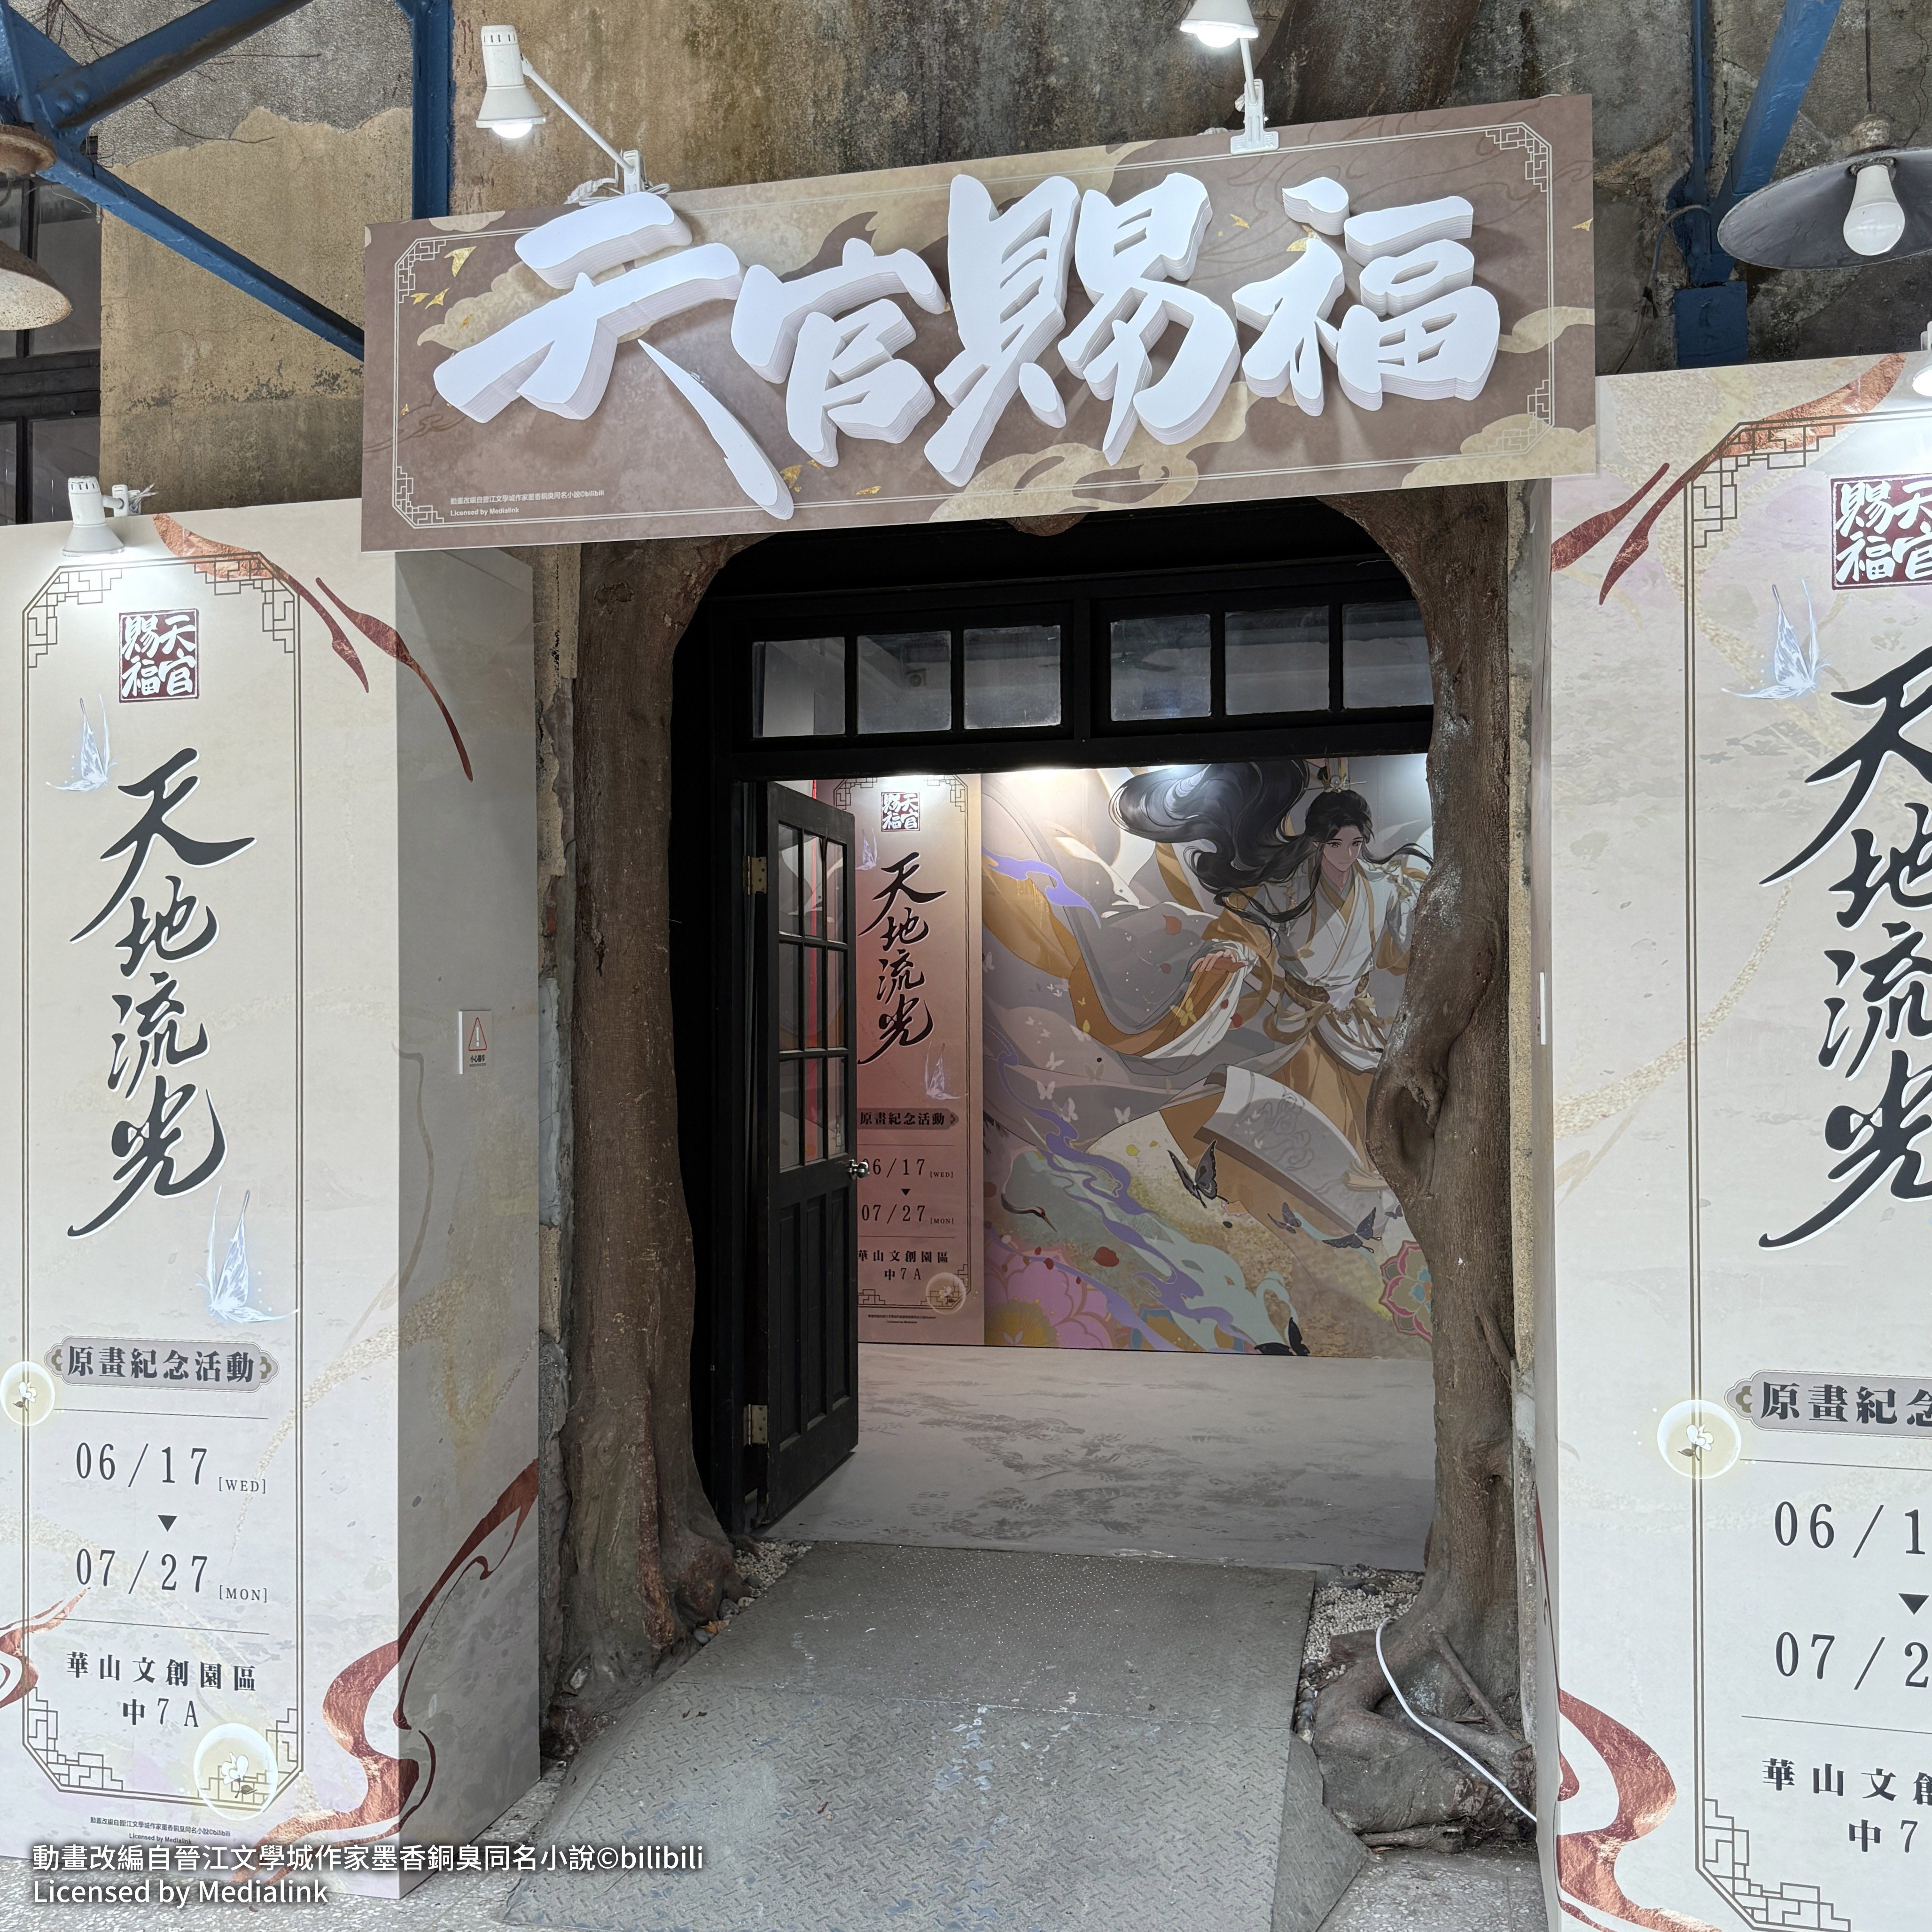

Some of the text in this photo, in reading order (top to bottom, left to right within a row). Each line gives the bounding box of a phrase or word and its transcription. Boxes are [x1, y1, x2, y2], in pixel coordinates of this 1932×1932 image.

[434, 172, 1501, 519] 天官賜福
[858, 852, 947, 1065] 天地流光
[68, 748, 256, 1237] 天地流光
[860, 1112, 944, 1125] 原畫紀念活動
[863, 1158, 925, 1178] 6/17
[862, 1204, 925, 1224] 07/27
[858, 1249, 948, 1263] 華山文創園區
[68, 1346, 254, 1383] 原畫紀念活動
[76, 1442, 208, 1488] 06/17
[76, 1548, 208, 1595] 07/27
[67, 1652, 256, 1691] 華山文創園區
[165, 1836, 192, 1845] Medialink
